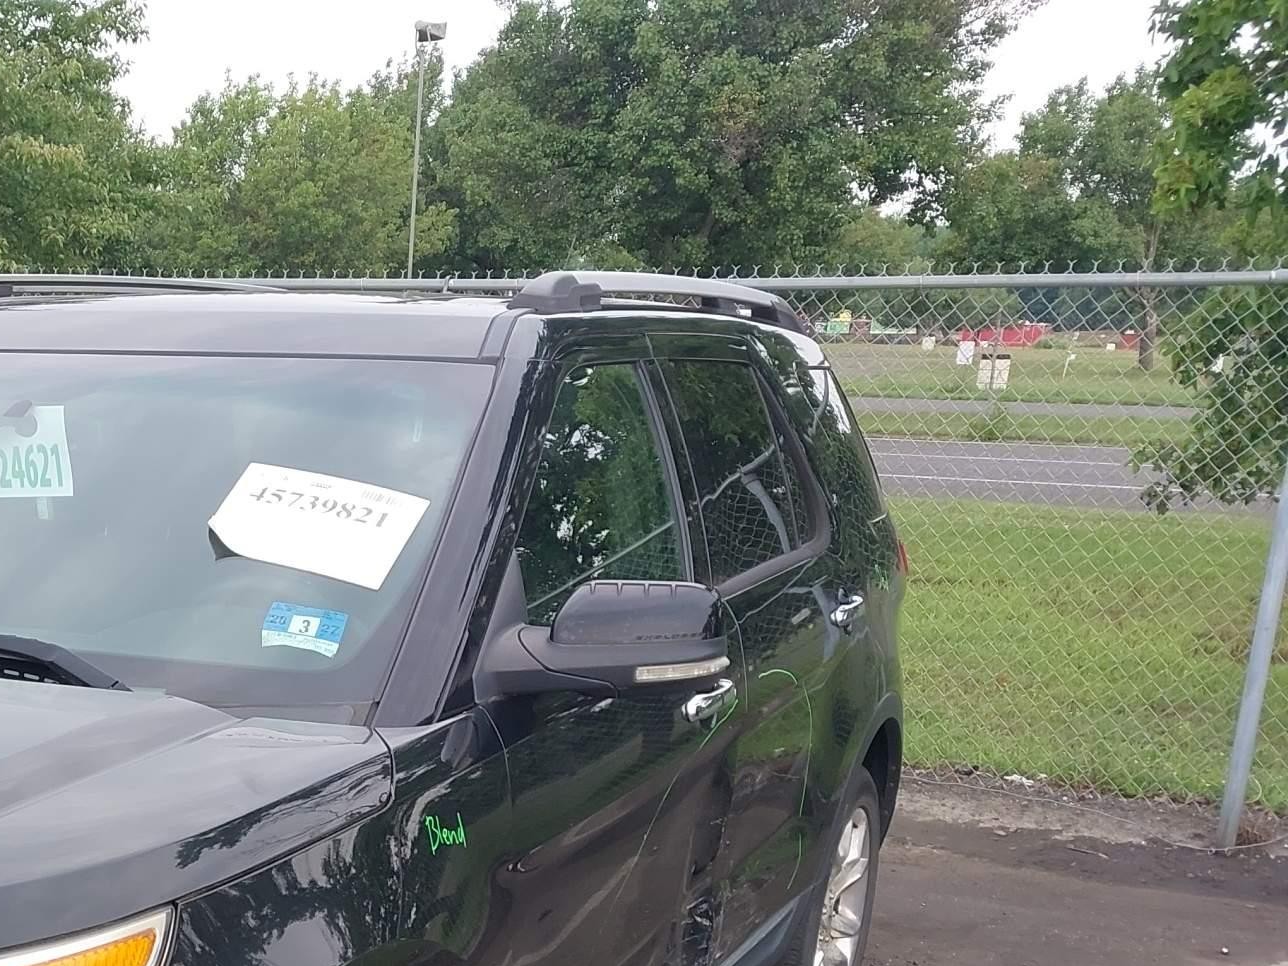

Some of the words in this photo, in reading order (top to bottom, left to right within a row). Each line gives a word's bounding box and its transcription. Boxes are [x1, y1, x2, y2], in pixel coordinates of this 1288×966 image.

[249, 487, 389, 527] 45739821
[298, 619, 311, 633] 3
[424, 811, 467, 855] Blend
